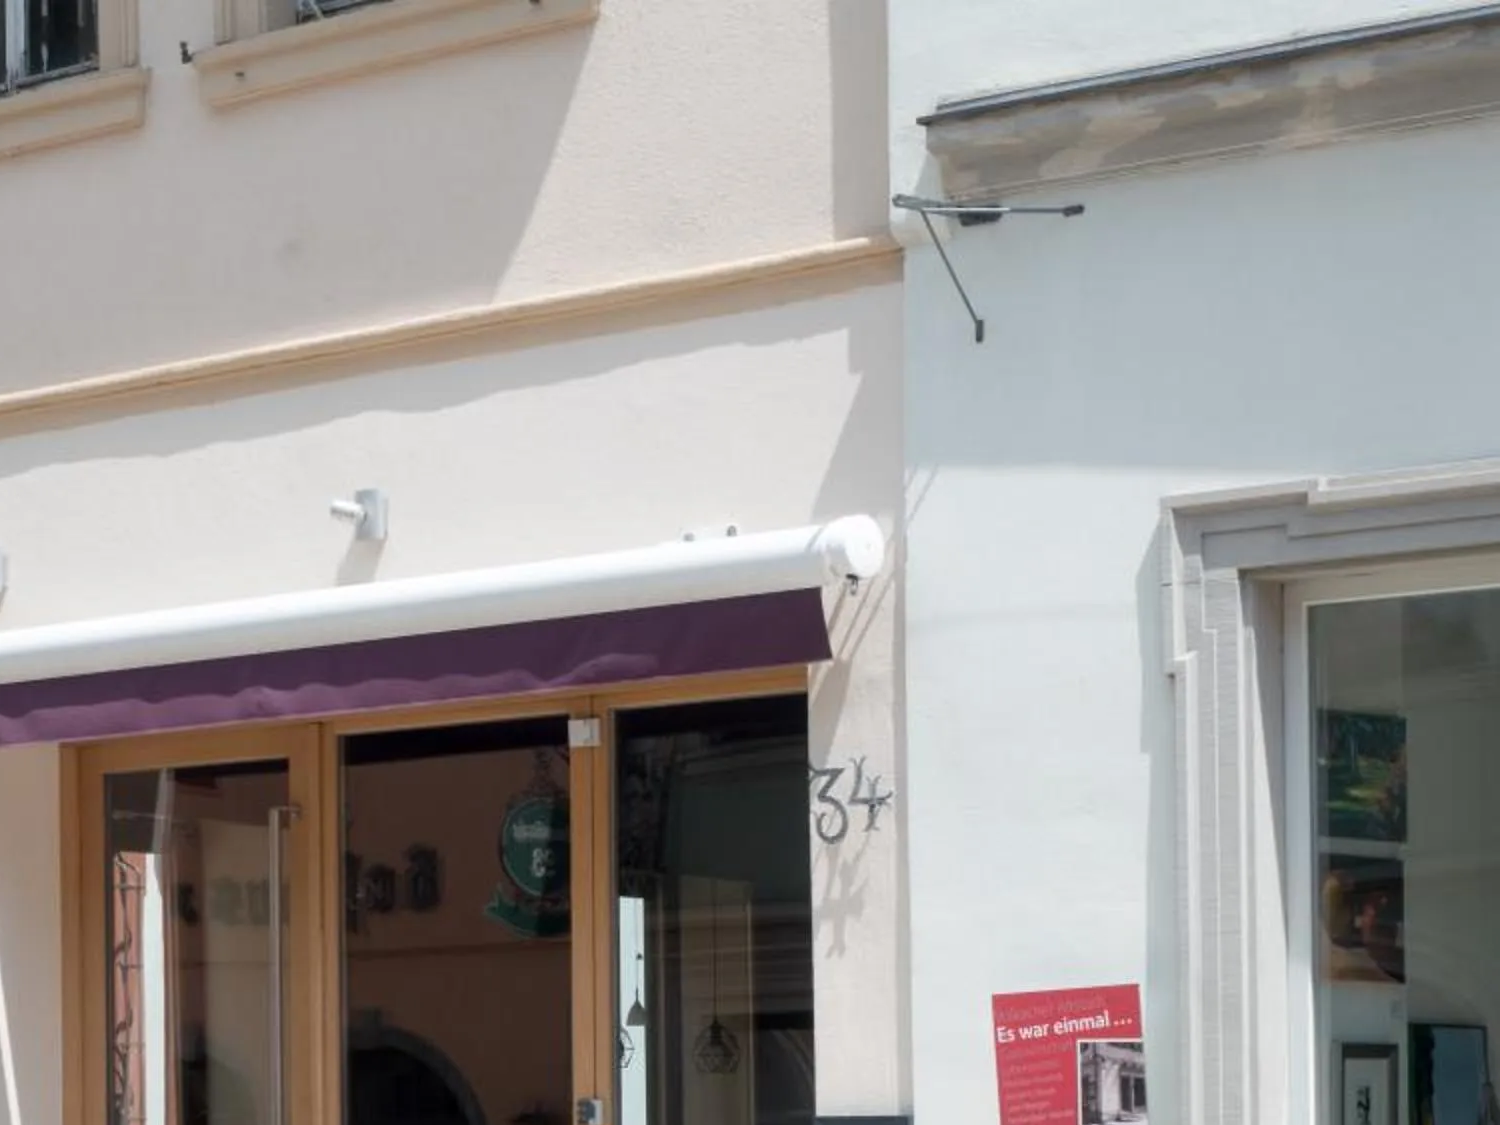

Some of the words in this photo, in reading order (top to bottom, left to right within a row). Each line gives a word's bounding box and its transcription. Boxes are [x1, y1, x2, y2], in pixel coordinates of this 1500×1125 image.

[808, 756, 893, 845] 34
[996, 1026, 1016, 1043] Es
[1018, 1023, 1049, 1039] war
[1053, 1009, 1111, 1035] einmal
